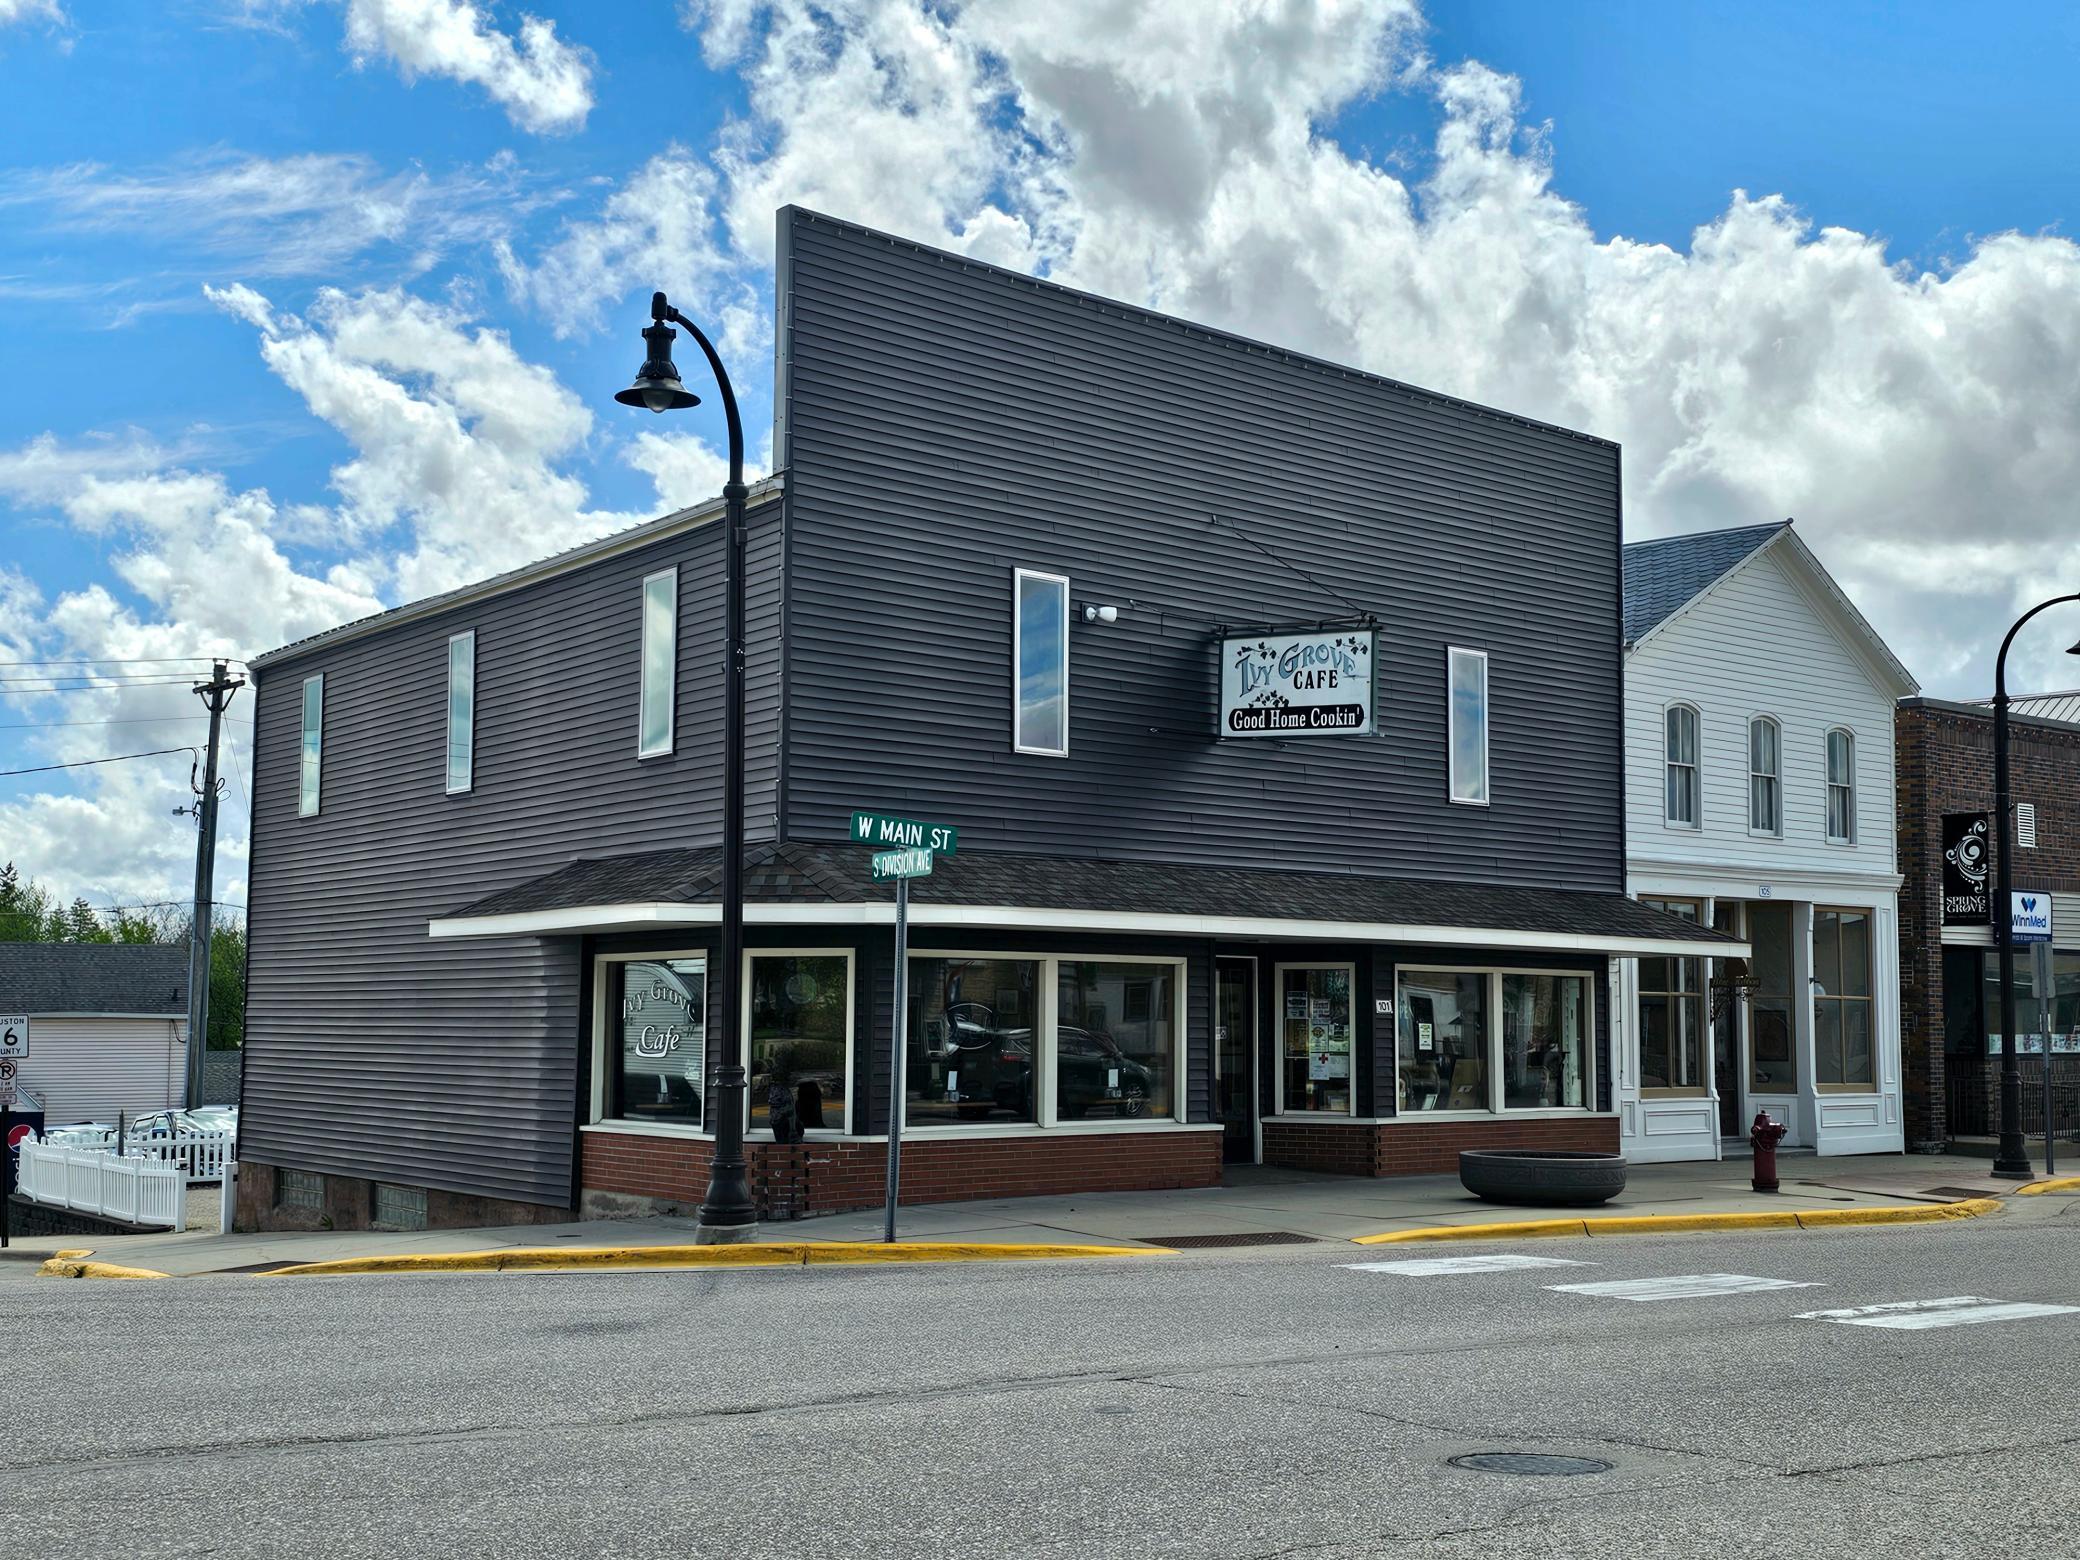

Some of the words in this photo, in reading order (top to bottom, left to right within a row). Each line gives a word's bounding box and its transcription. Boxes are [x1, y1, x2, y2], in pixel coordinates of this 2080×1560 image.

[1293, 669, 1339, 690] CAFE
[1233, 709, 1266, 730] Good
[1269, 708, 1306, 728] Home
[1310, 706, 1360, 727] Cookin'
[858, 816, 873, 838] W
[879, 819, 923, 846] MAIN
[930, 828, 952, 850] ST
[873, 857, 879, 878] S
[881, 850, 915, 877] DIVISION
[916, 849, 931, 872] AVE
[1946, 895, 1986, 905] SPRING
[2012, 914, 2047, 928] WinnMed
[1378, 1001, 1390, 1011] 101
[4, 1027, 18, 1046] 6
[636, 1025, 680, 1058] Cafe
